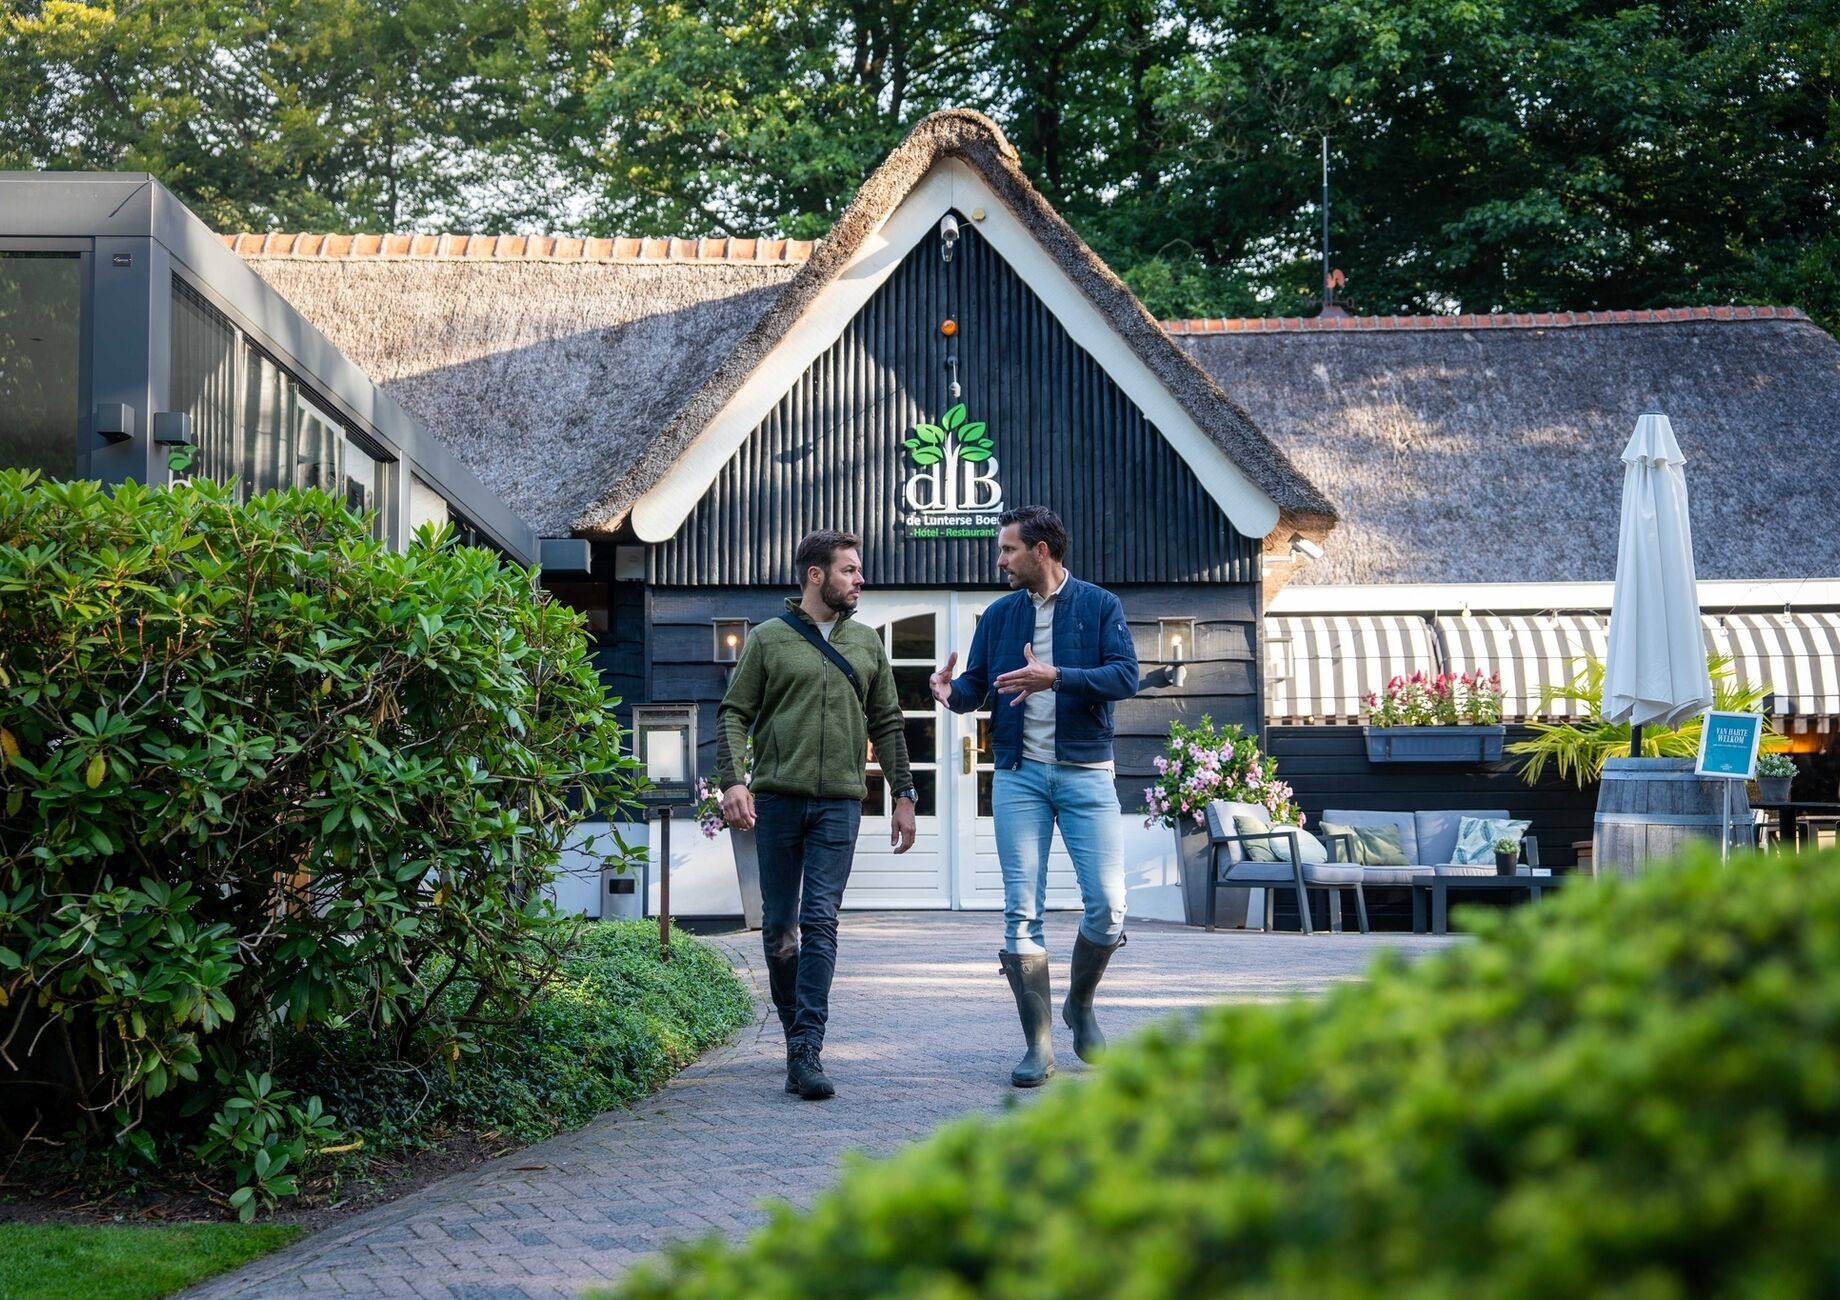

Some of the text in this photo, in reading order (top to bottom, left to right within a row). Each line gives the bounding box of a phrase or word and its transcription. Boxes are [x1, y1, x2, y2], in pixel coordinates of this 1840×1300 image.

[906, 515, 921, 525] de
[924, 515, 972, 525] Lunterse
[946, 528, 995, 537] Restaurant
[1716, 727, 1748, 736] VAN HARTE
[1718, 734, 1745, 744] WELKOM
